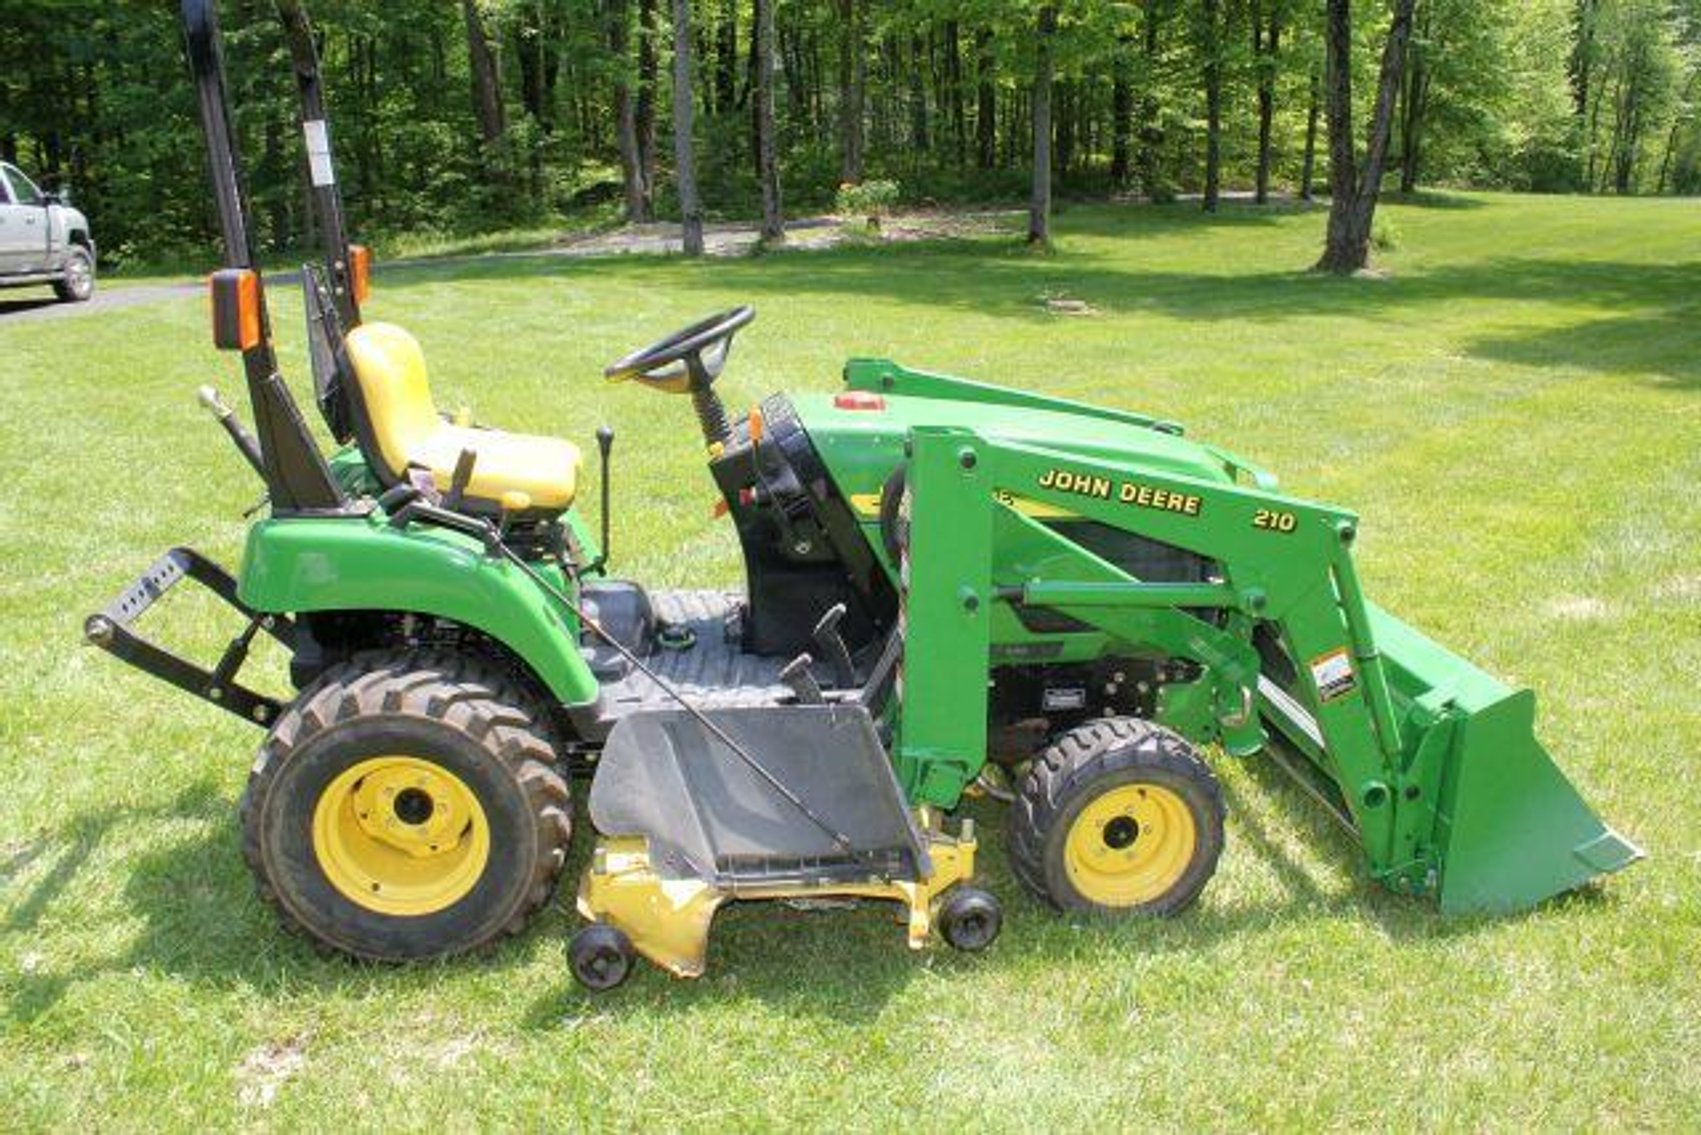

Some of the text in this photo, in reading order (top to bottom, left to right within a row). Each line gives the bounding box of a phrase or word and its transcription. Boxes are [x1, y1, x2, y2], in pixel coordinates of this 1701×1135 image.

[1039, 469, 1110, 499] JOHN
[1120, 483, 1201, 515] DEERE
[1253, 509, 1296, 533] 210
